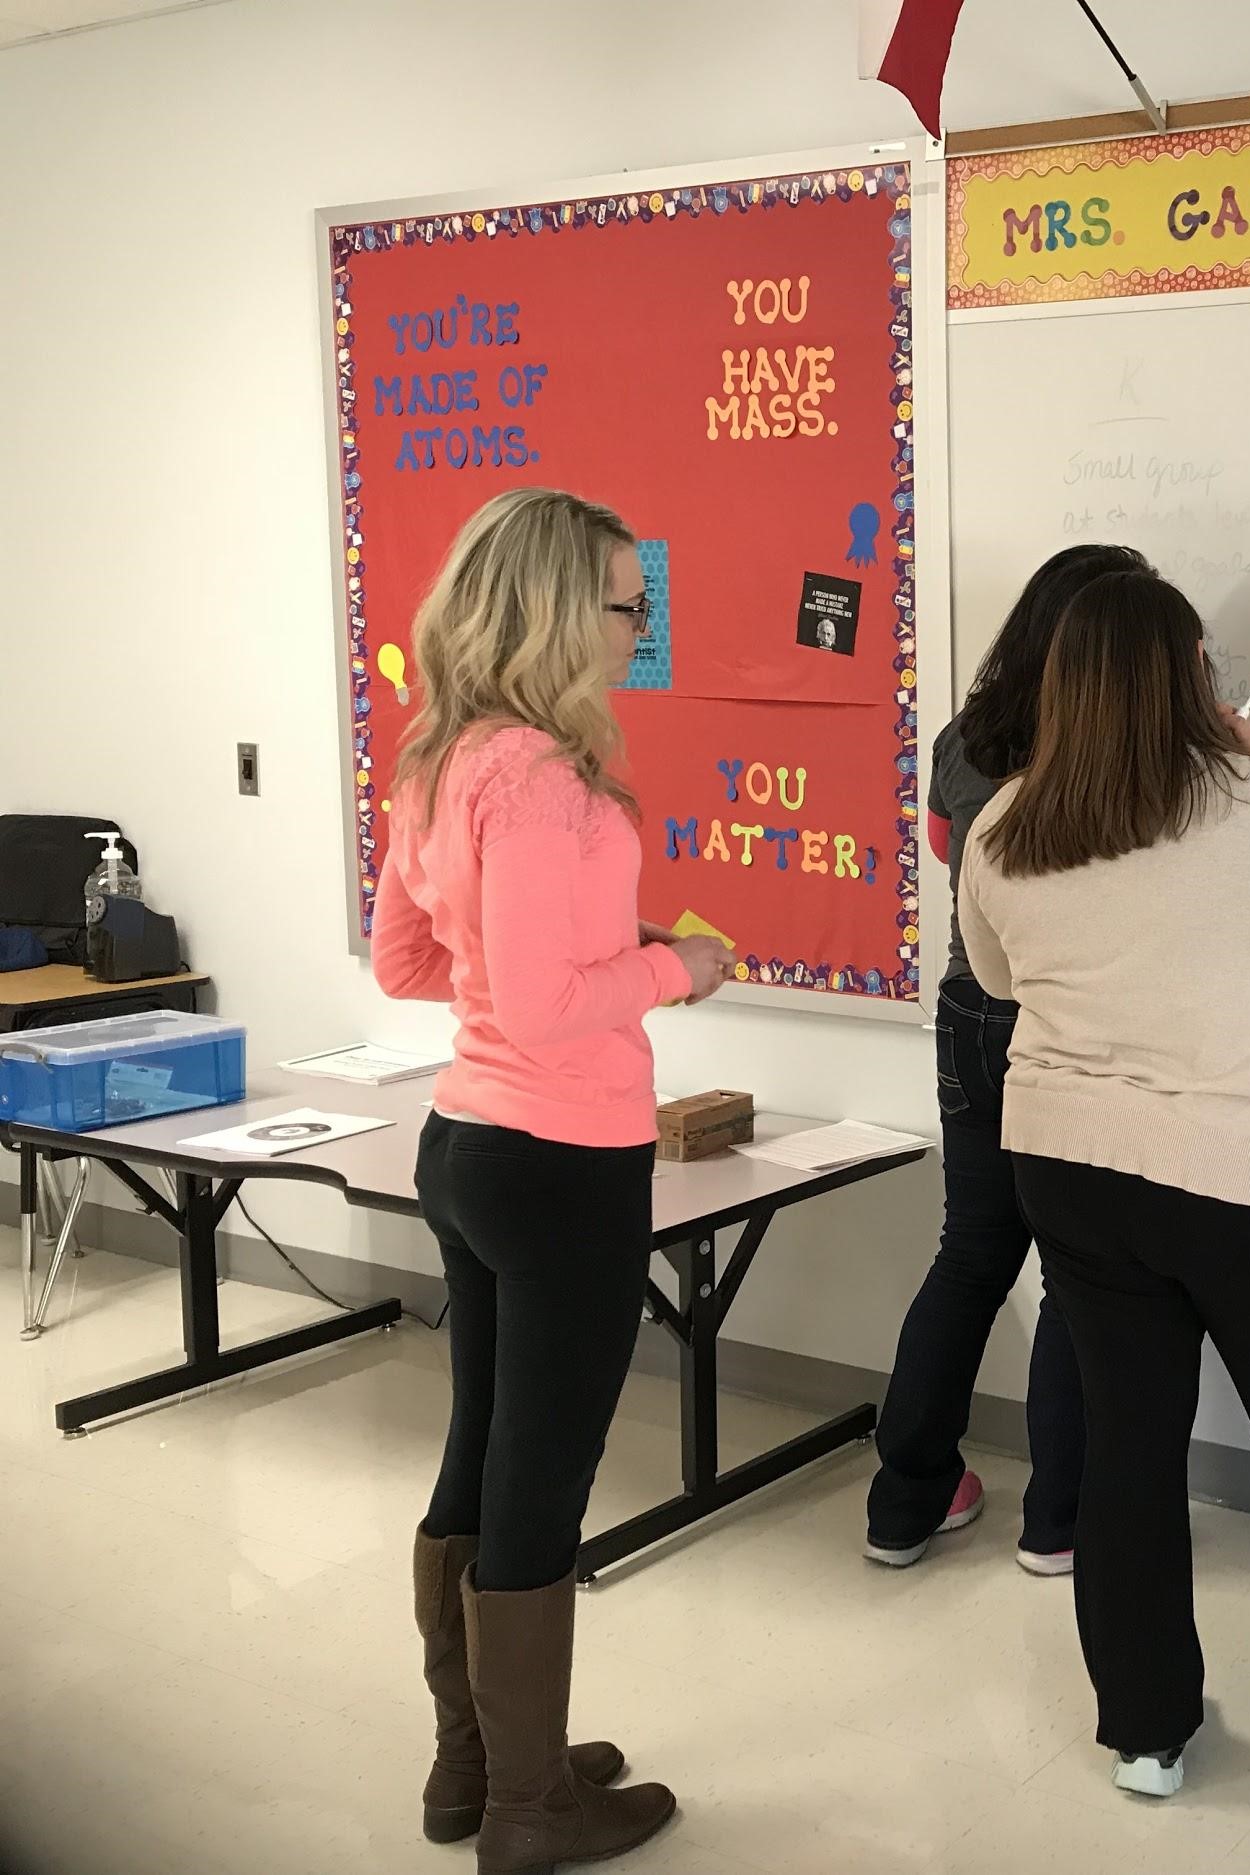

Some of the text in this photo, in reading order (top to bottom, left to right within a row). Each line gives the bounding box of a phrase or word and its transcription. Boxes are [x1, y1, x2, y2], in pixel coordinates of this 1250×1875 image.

[1003, 197, 1125, 257] MRS.
[388, 294, 520, 354] YOU'RE
[727, 275, 810, 325] YOU
[373, 363, 548, 416] MADE OF
[722, 345, 836, 394] HAVE
[705, 391, 839, 440] MASS.
[395, 425, 541, 471] ATOMS.
[717, 759, 807, 811] YOU
[664, 816, 876, 885] MATTER!
